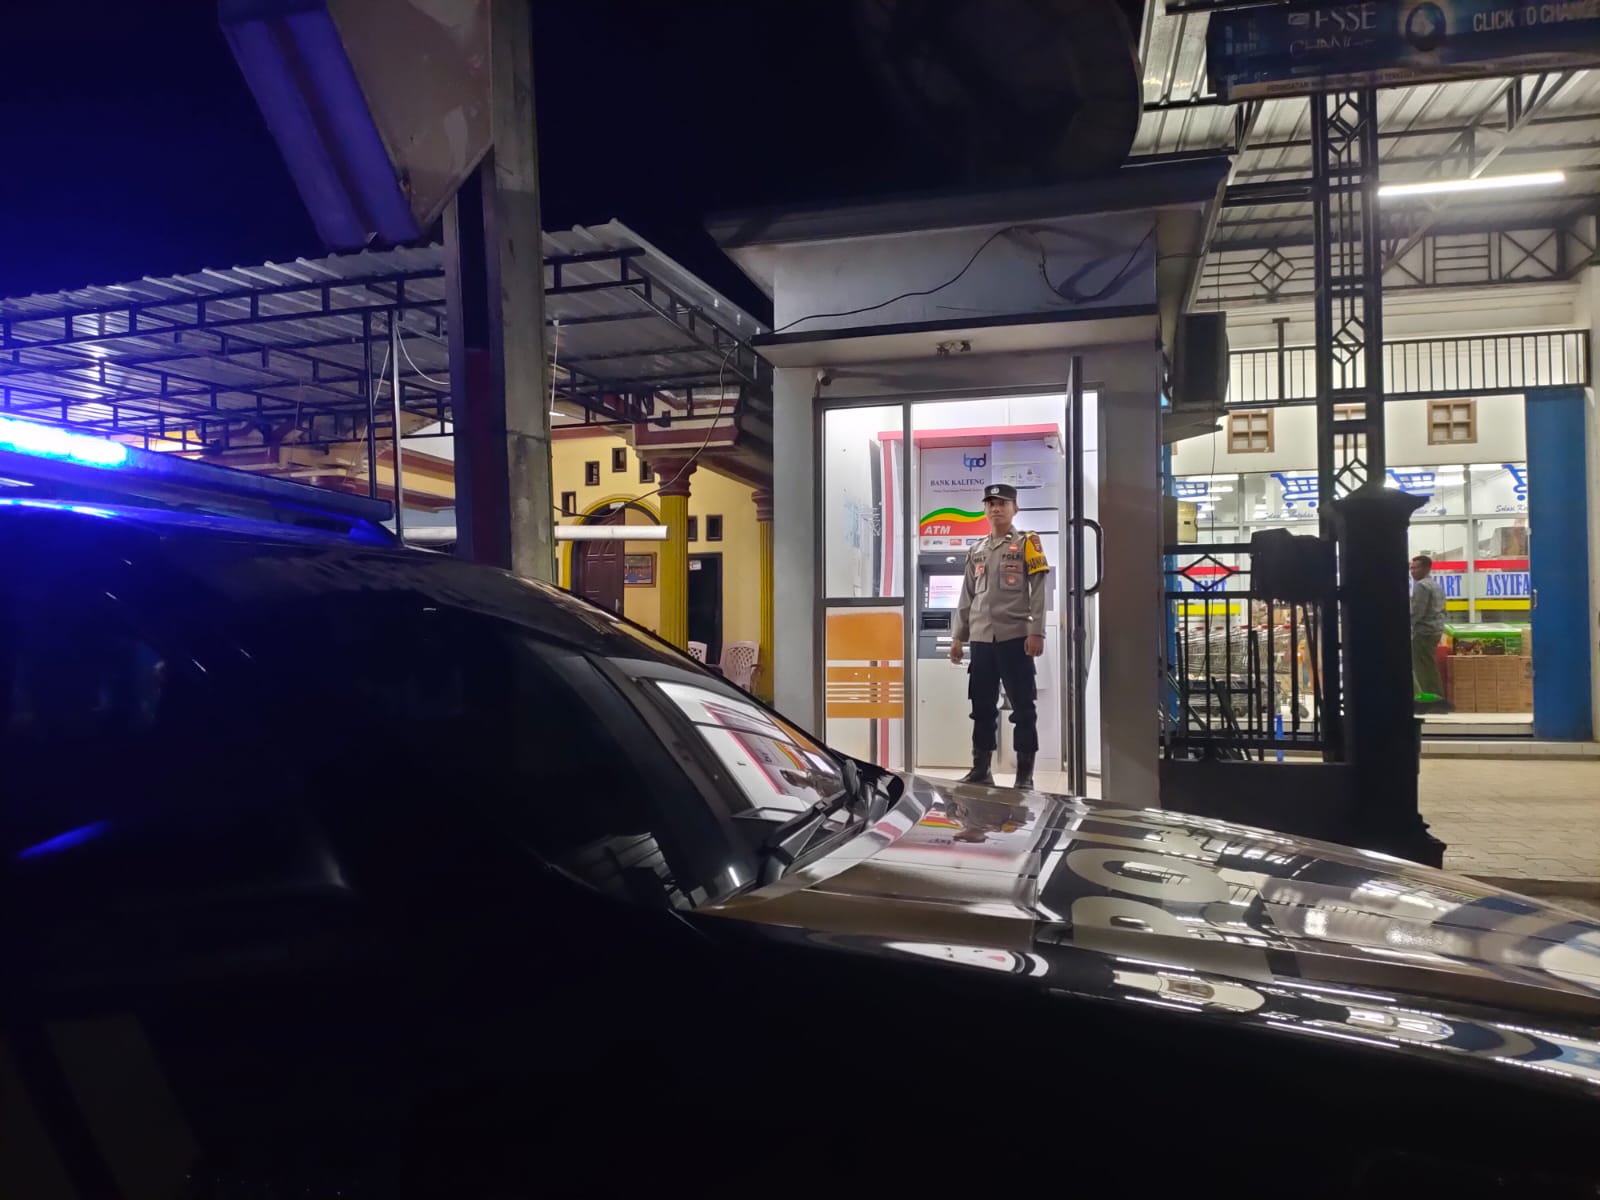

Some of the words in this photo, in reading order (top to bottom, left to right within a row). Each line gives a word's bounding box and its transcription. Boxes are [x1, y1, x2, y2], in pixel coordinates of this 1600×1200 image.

[1473, 8, 1514, 31] CLICK
[930, 479, 950, 487] BANK
[951, 478, 985, 486] KALTENG
[924, 525, 951, 535] ATM
[1432, 575, 1462, 598] ART
[1486, 574, 1530, 597] ASYIFA
